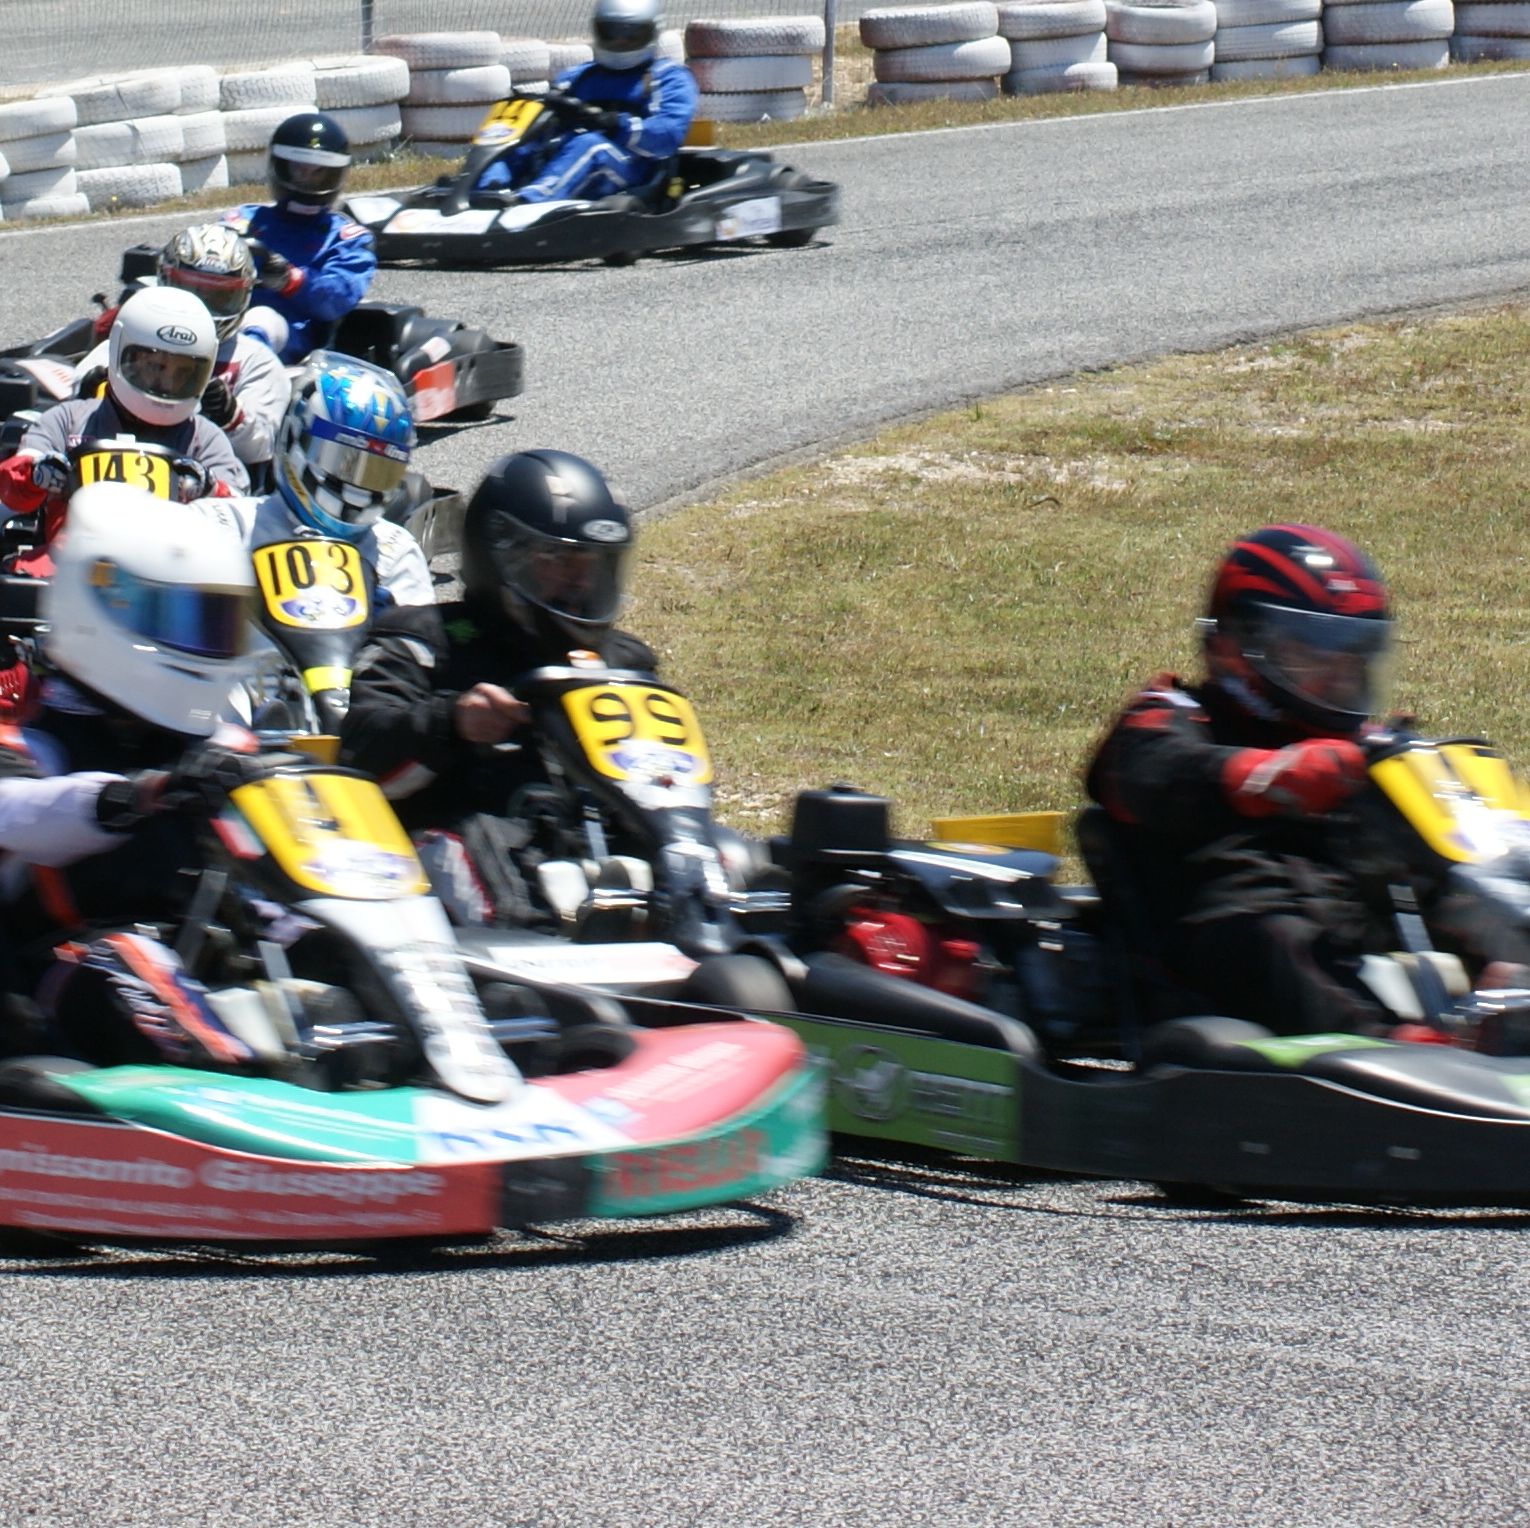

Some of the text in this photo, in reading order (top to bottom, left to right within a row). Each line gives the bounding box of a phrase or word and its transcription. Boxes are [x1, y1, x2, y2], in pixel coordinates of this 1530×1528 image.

[161, 326, 193, 342] Arai
[92, 454, 156, 493] 143
[267, 544, 354, 596] 103
[589, 691, 687, 746] 99
